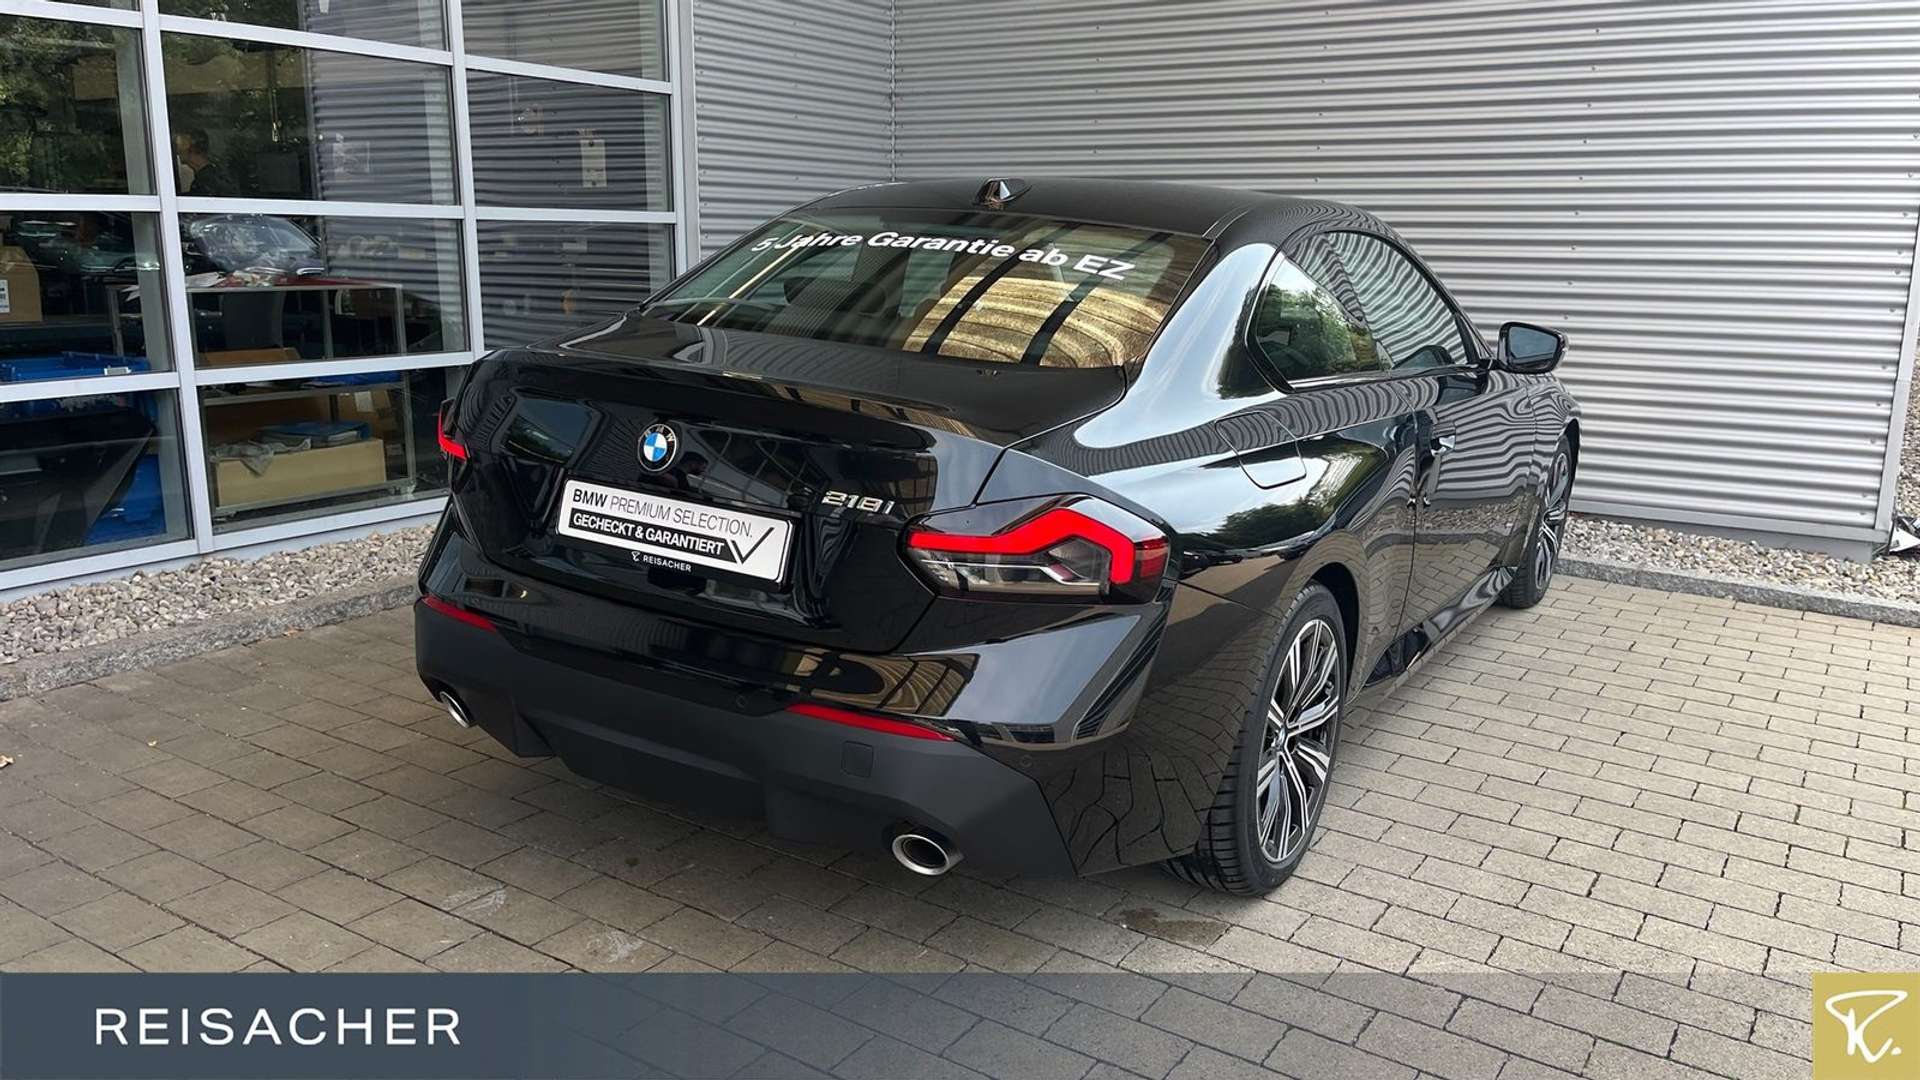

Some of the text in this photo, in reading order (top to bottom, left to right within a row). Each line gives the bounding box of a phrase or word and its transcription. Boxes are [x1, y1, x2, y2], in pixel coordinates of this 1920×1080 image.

[751, 231, 1136, 281] 5 Jahre Garantie ab EZ
[572, 488, 608, 509] BMW
[609, 495, 670, 522] PREMIUM
[573, 512, 725, 556] GECHECKT & GARANTIERT
[643, 554, 692, 572] REISACHER
